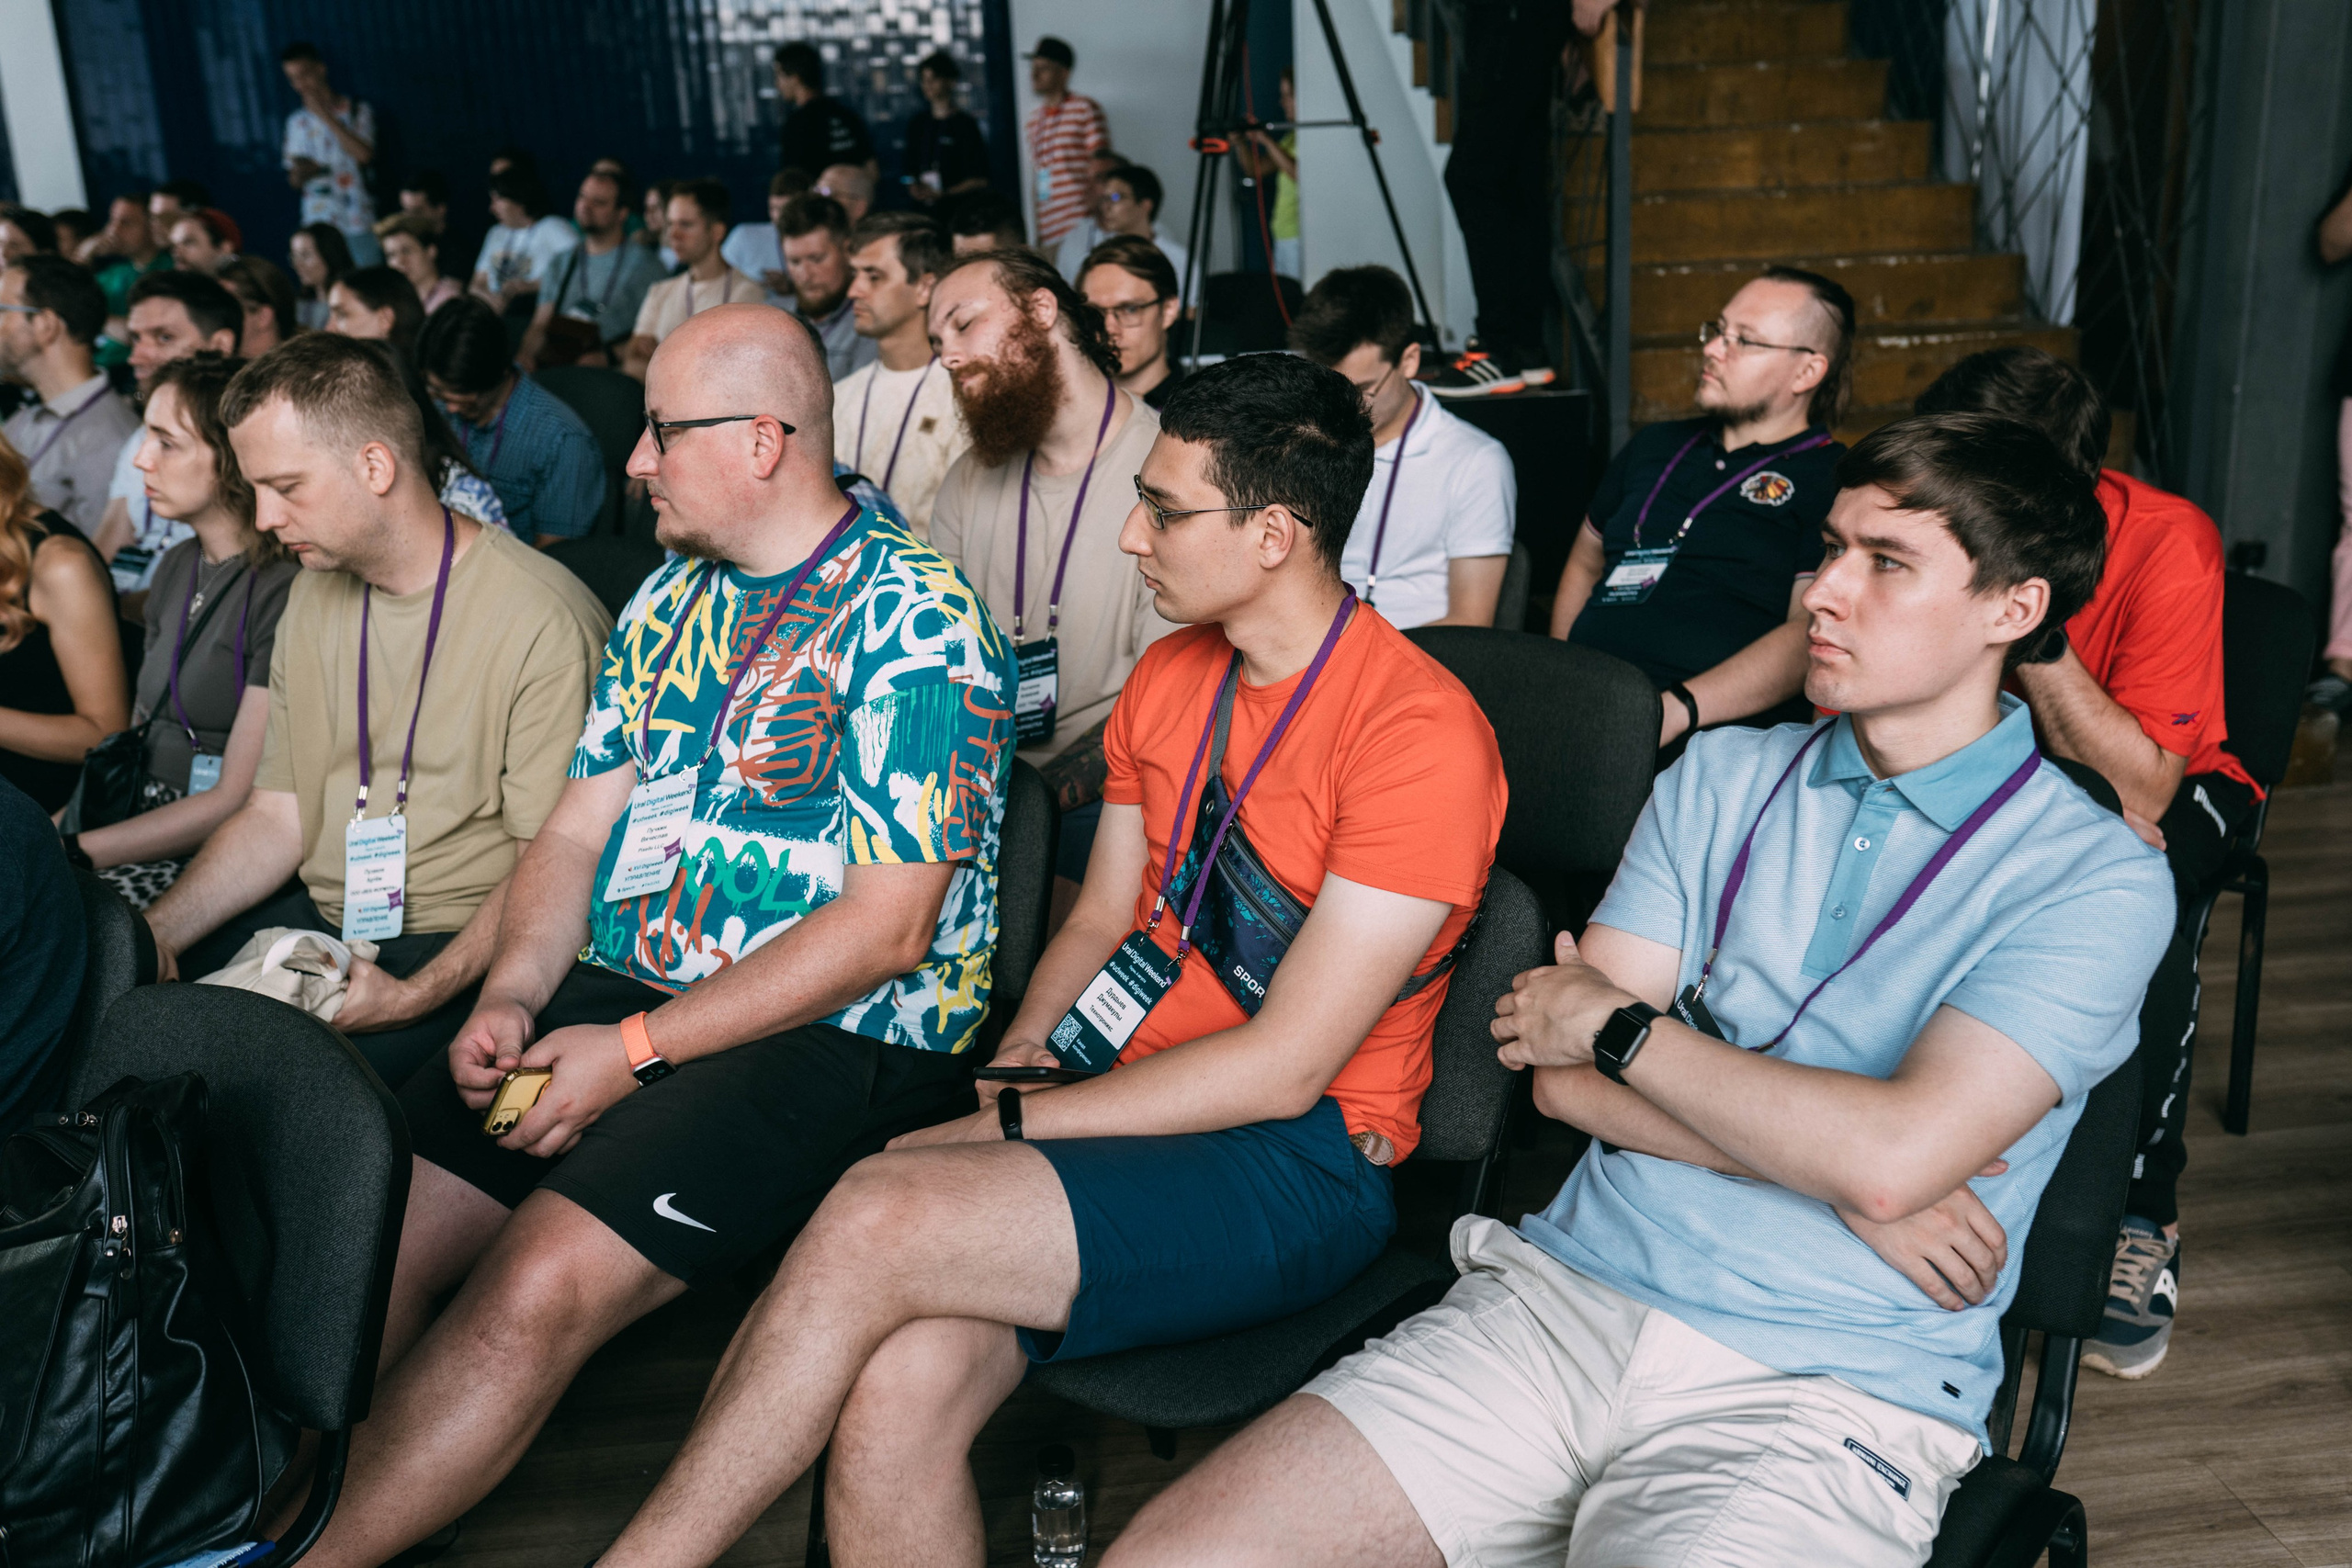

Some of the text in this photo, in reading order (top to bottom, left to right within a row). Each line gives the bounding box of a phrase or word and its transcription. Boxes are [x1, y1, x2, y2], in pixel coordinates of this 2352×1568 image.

[634, 800, 646, 809] Ural
[646, 795, 665, 807] Digital
[665, 787, 692, 801] Weekend
[632, 814, 657, 824] #udweek
[660, 805, 689, 817] #digiweek
[1122, 942, 1135, 956] Ural
[1130, 950, 1148, 968] Digital
[1144, 964, 1168, 988] Weekend
[1109, 961, 1130, 983] #udweek
[1128, 979, 1153, 1006] #digiweek
[1233, 964, 1265, 998] SPOR
[1105, 987, 1126, 1010] Дурдыев
[1677, 999, 1690, 1019] Ural
